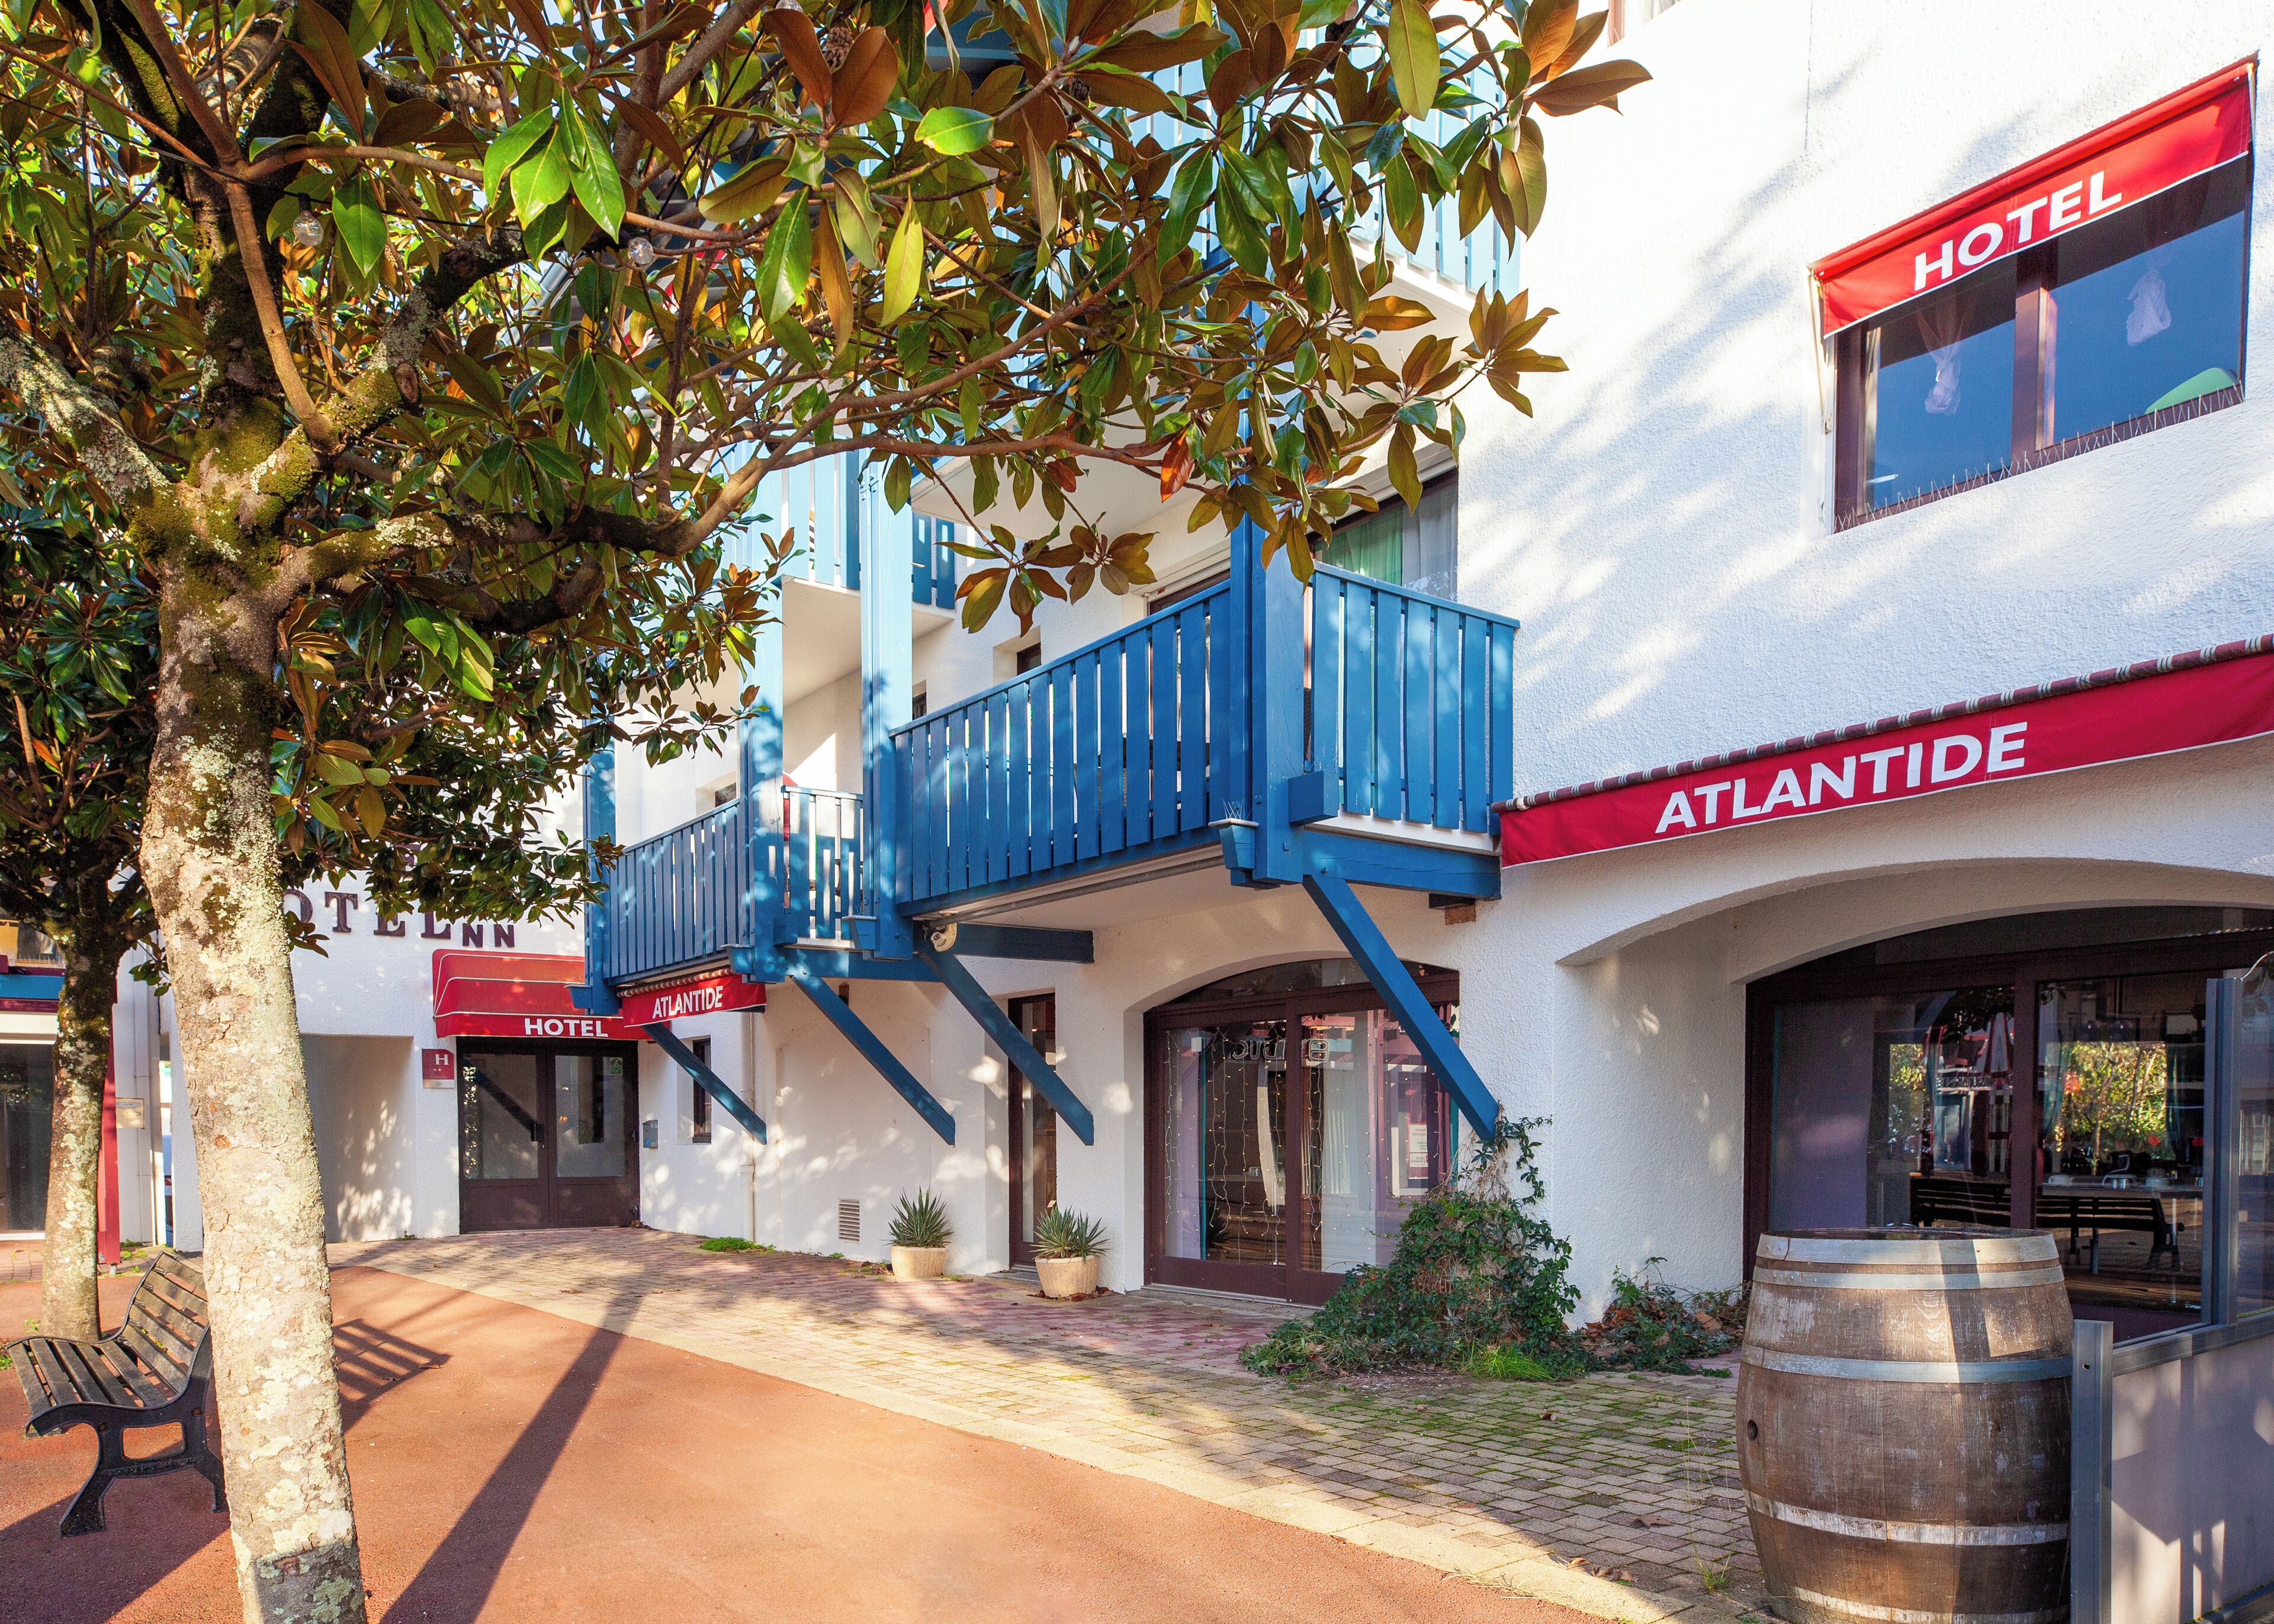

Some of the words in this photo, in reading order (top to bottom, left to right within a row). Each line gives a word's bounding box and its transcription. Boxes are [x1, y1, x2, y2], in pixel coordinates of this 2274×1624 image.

[1913, 170, 2122, 291] HOTEL
[1655, 721, 2028, 834] ATLANTIDE
[282, 888, 451, 940] OTEL
[652, 985, 723, 1019] ATLANTIDE
[524, 1018, 609, 1037] HOTEL
[435, 1054, 449, 1066] H
